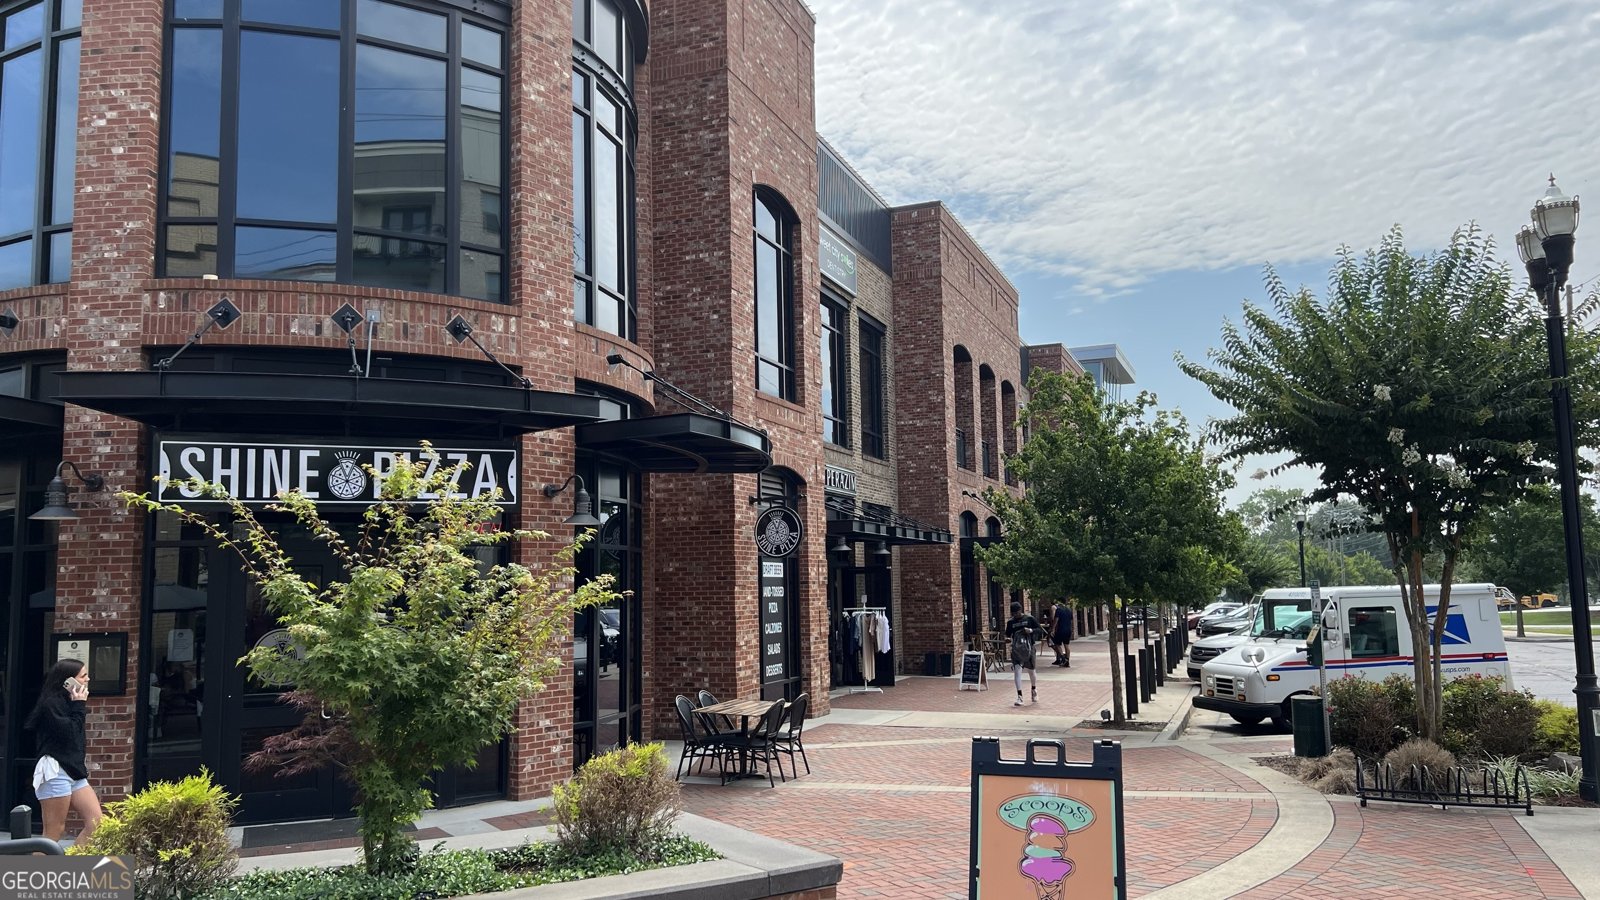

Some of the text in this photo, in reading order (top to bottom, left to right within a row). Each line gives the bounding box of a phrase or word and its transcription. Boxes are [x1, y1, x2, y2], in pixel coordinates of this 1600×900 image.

[180, 447, 498, 500] SHINE PZZA
[757, 532, 798, 554] SHINE PIZZA
[768, 602, 778, 612] PIZZA
[765, 622, 782, 634] CALZONES
[767, 643, 780, 655] SALADS
[766, 663, 782, 676] DESSERTS
